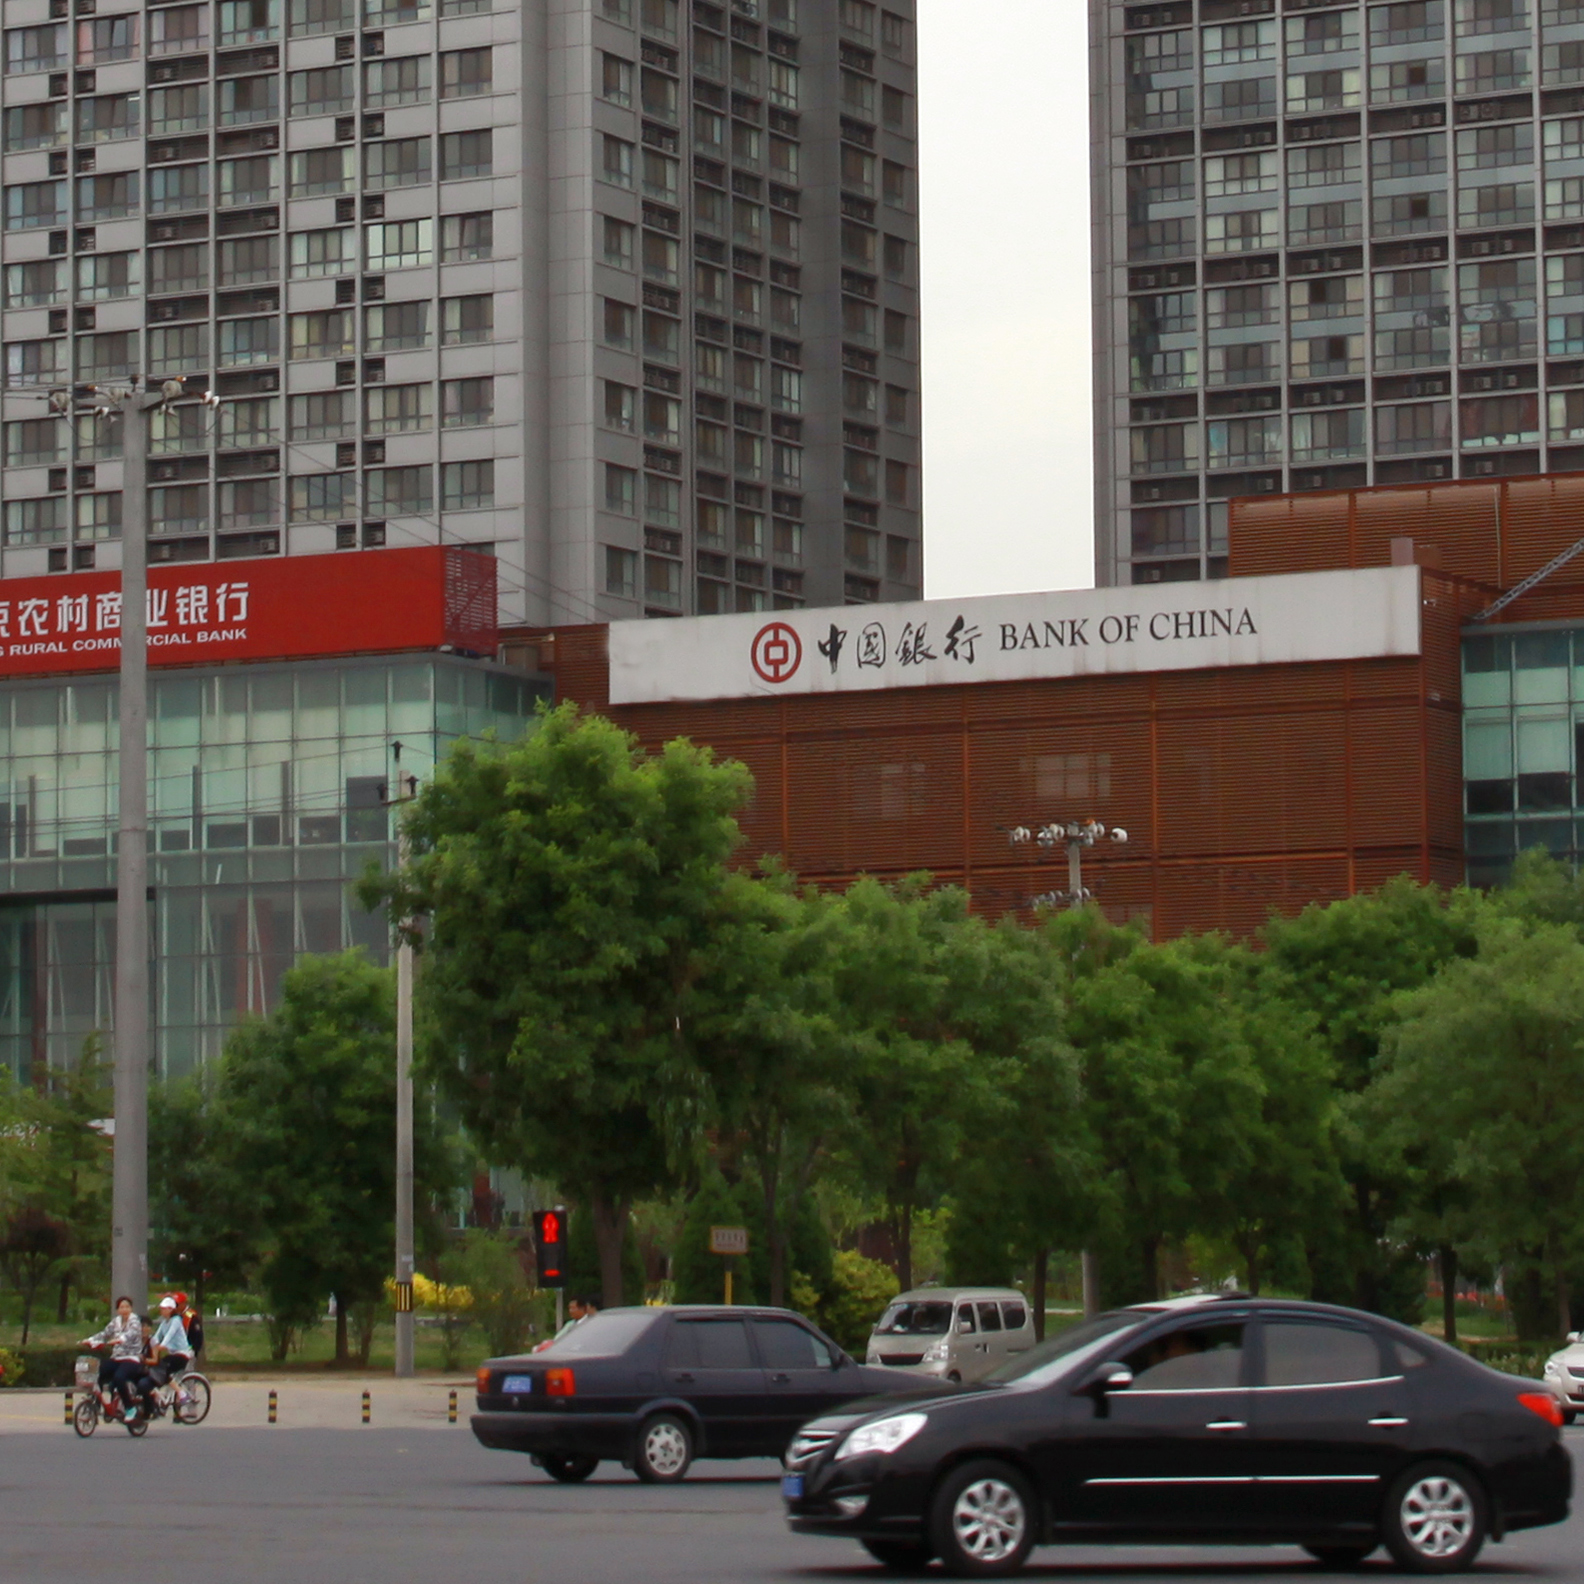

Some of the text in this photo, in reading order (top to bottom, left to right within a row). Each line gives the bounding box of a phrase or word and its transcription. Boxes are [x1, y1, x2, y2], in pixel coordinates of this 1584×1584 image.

[9, 641, 68, 656] RURAL
[72, 633, 192, 652] COMMRCIAL
[197, 628, 247, 643] BANK
[999, 607, 1258, 651] BANK OF CHINA
